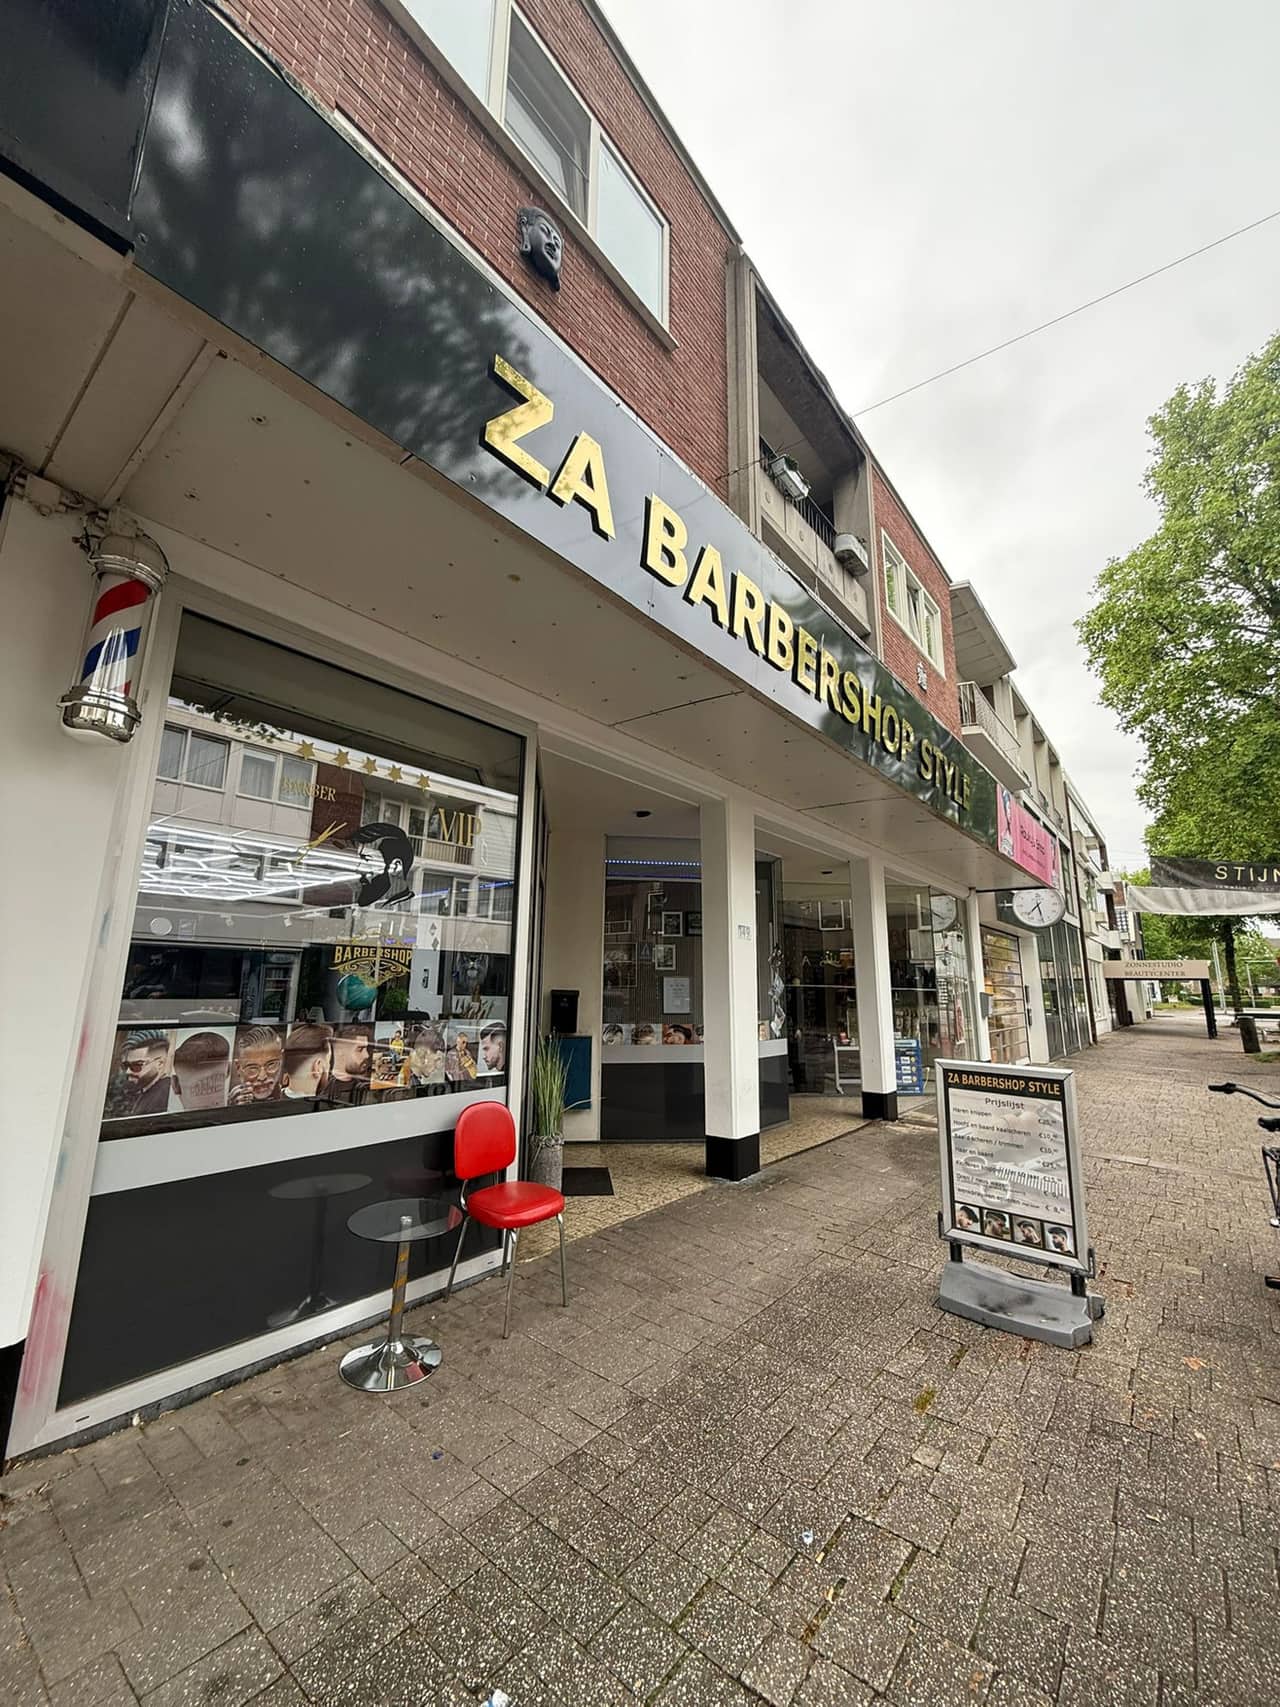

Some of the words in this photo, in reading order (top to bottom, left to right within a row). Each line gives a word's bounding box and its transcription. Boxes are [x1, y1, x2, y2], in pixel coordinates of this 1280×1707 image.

[480, 353, 617, 541] ZA
[640, 492, 916, 760] BARBERSHOP
[916, 736, 972, 811] STYLE
[438, 807, 482, 848] VIP
[334, 945, 413, 966] BARBERSHOP
[948, 1073, 960, 1083] ZA
[961, 1074, 1026, 1090] BARBERSHOP
[1028, 1081, 1060, 1095] STYLE
[985, 1097, 1025, 1110] Prijslijst
